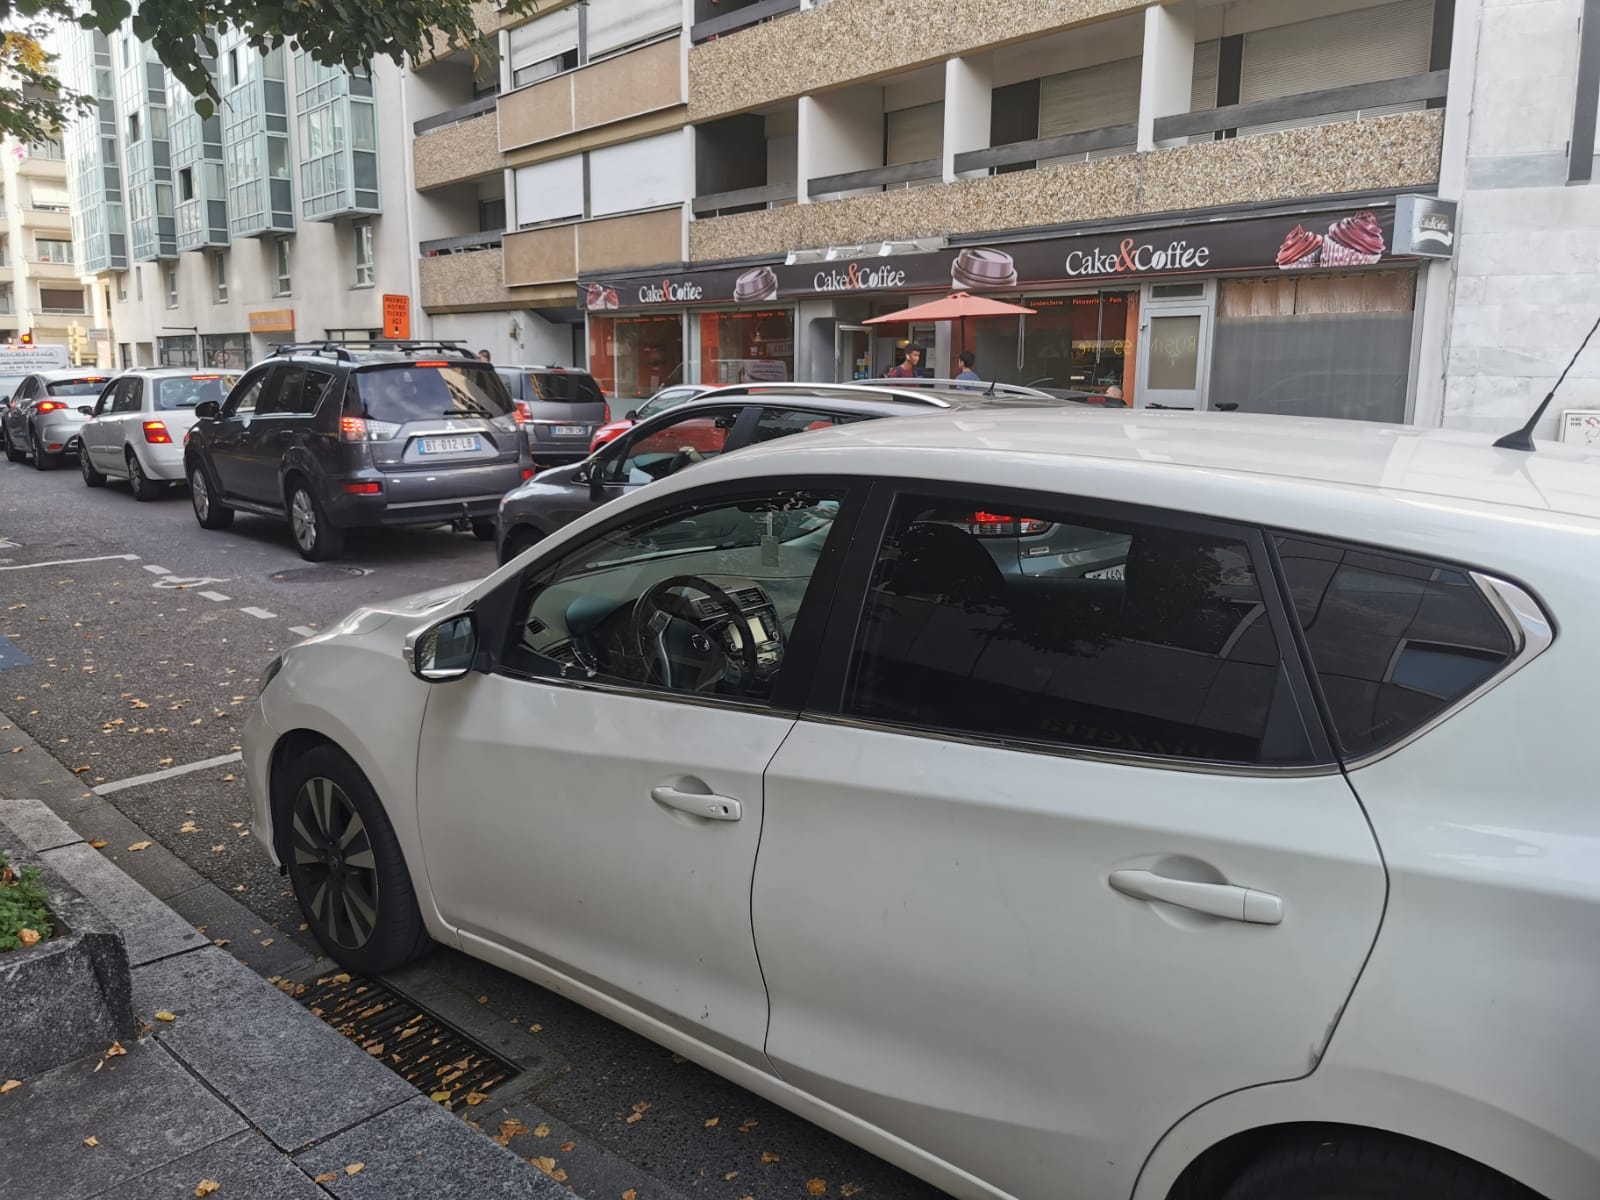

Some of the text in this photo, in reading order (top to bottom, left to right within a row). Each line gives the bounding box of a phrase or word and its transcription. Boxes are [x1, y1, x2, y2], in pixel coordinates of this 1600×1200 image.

[1065, 238, 1209, 275] Cake&Coffee
[639, 279, 703, 303] Cake&Coffee
[813, 262, 905, 292] Cake&Coffee
